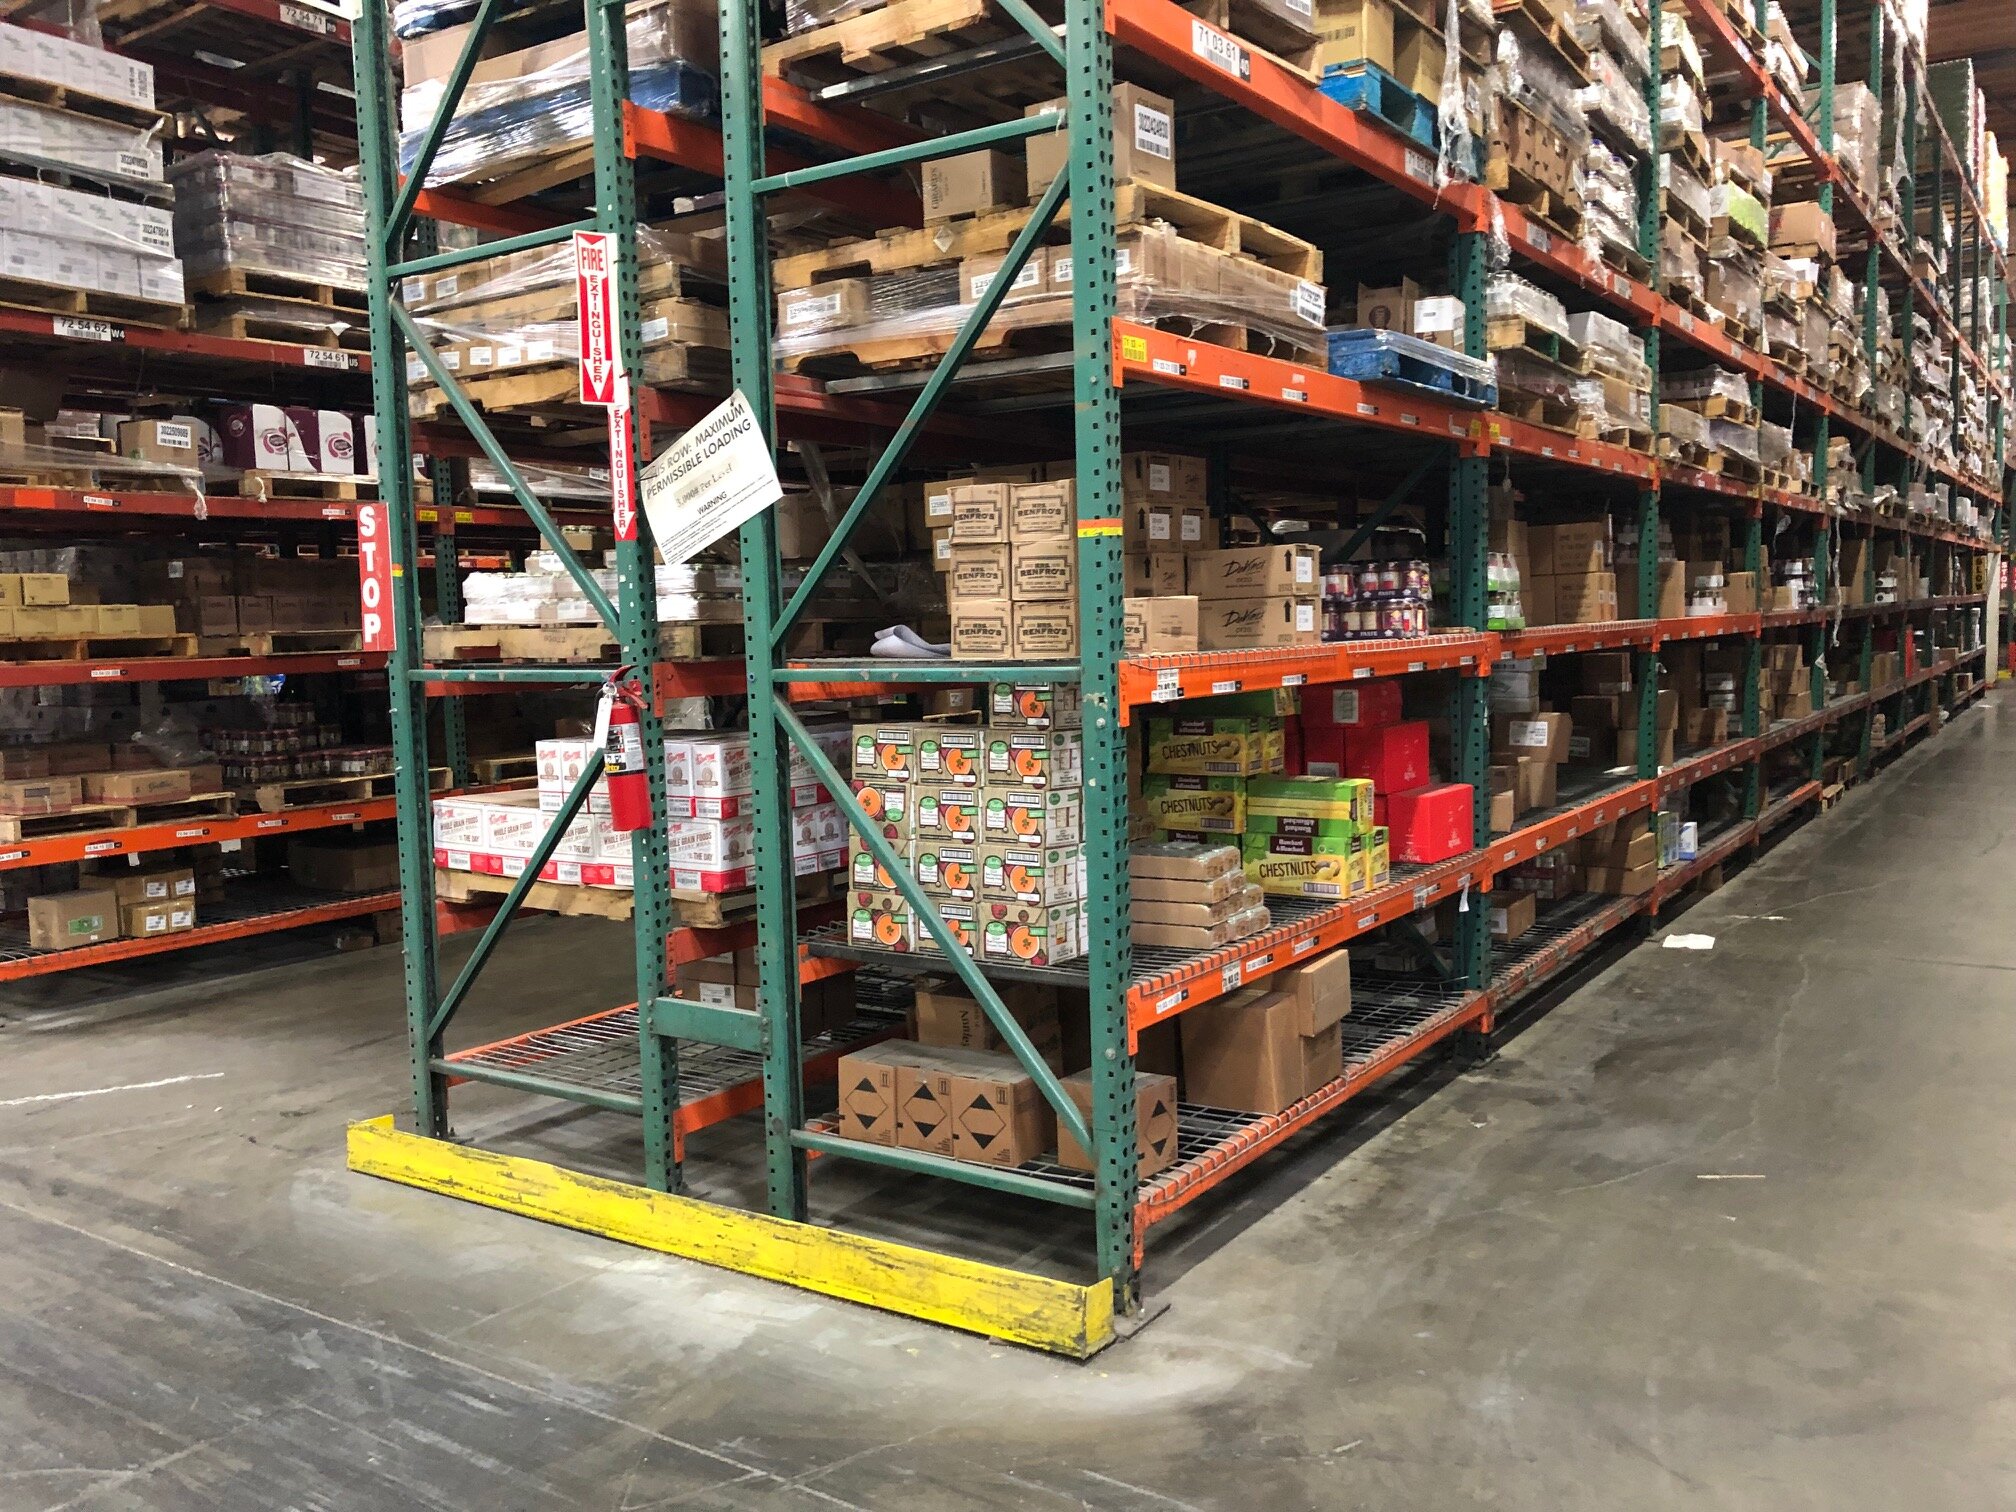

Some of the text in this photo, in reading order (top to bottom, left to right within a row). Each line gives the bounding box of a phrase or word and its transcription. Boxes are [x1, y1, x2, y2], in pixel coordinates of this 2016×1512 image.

[582, 246, 604, 272] FIRE
[60, 317, 74, 329] 72
[78, 320, 91, 330] 54
[94, 322, 108, 333] 62
[590, 274, 603, 384] EXTINGUISHER
[310, 350, 320, 360] 72
[322, 352, 333, 361] 54
[335, 354, 345, 362] 61
[668, 444, 692, 468] ROW:
[695, 403, 746, 448] MAXIMUM
[614, 409, 626, 528] EXTINGUISHER
[646, 418, 752, 500] PERMISSIBLE LOADING
[697, 490, 728, 515] WARNING
[1018, 508, 1062, 517] RENFRO'S
[359, 505, 382, 643] STOP
[1020, 568, 1066, 577] RENFRO'S
[1162, 740, 1219, 760] CHESTNUTS
[1160, 796, 1213, 814] CHESTNUTS
[681, 835, 696, 846] GRAIN
[696, 832, 712, 842] FOODS
[1260, 860, 1318, 878] CHESTNUTS
